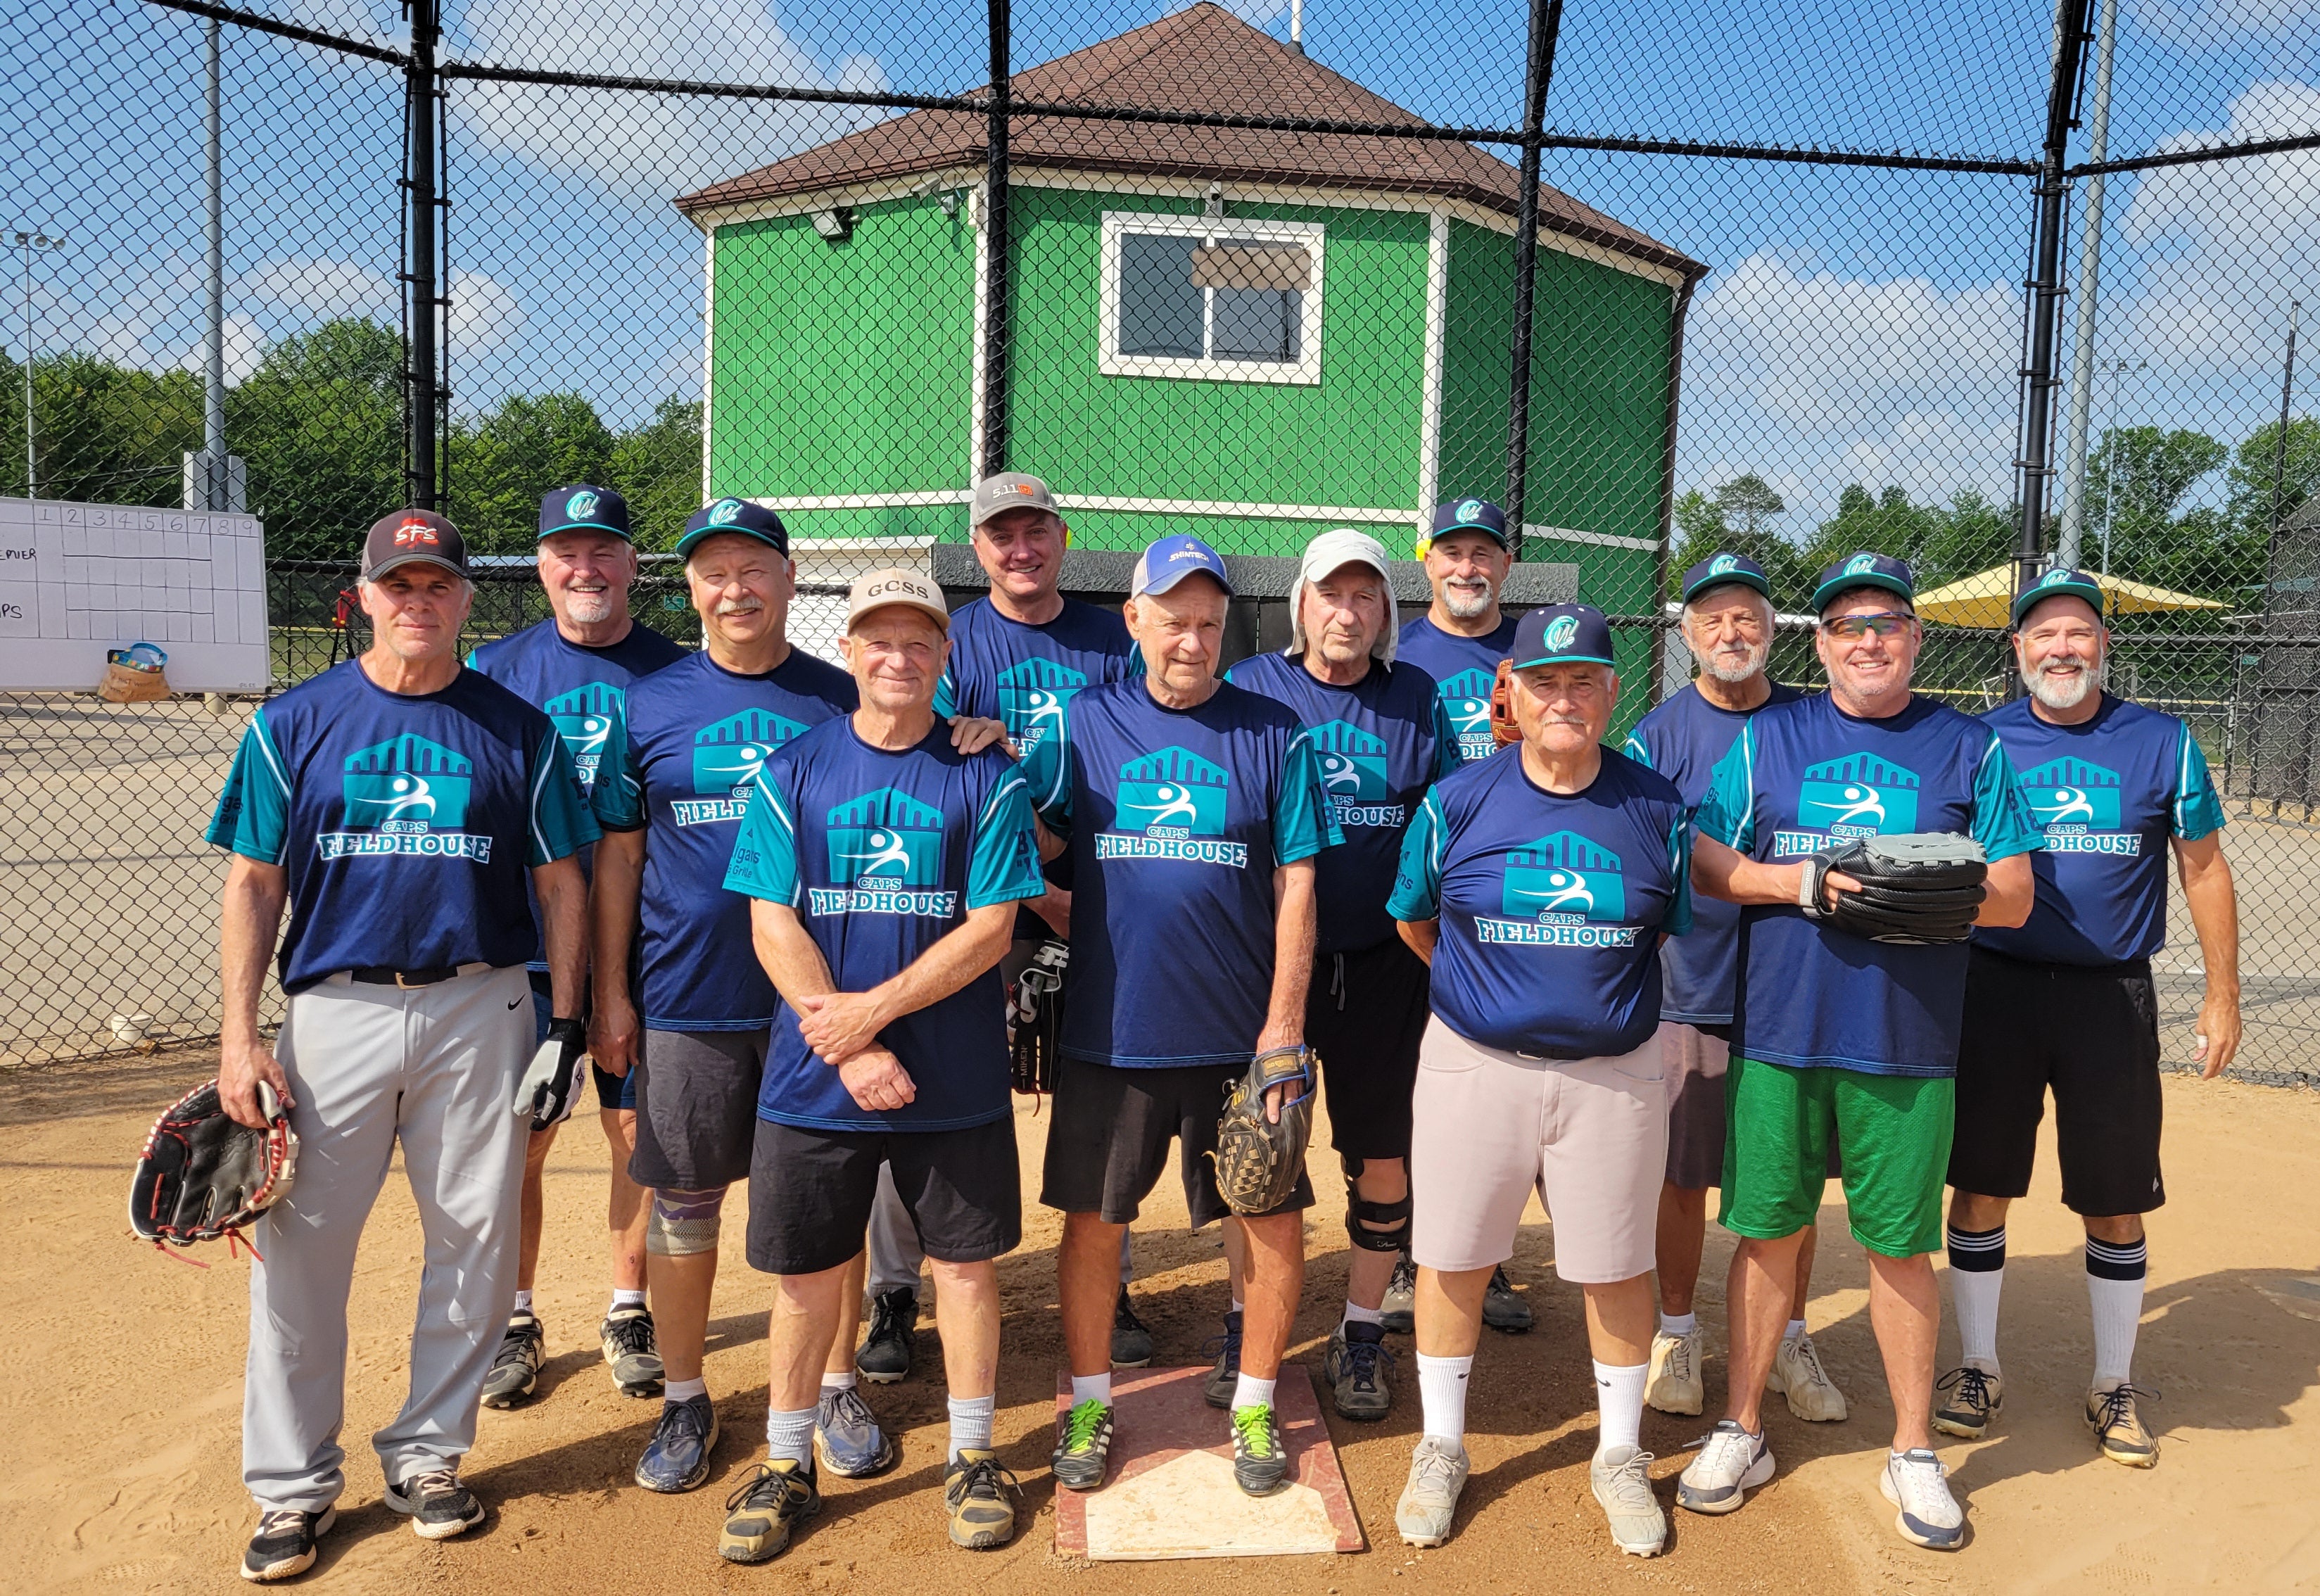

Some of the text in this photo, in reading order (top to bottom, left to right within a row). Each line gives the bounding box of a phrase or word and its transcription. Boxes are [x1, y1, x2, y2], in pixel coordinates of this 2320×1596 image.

[992, 483, 1019, 499] 5.11
[39, 509, 253, 536] 1 2 3 4 5 6 7 8 9
[395, 524, 437, 543] SFS
[868, 580, 929, 599] GCSS
[0, 603, 23, 619] PS
[1459, 733, 1493, 743] CAPS
[382, 820, 429, 833] CAPS
[1146, 825, 1190, 840] CAPS
[1830, 824, 1877, 838] CAPS
[2046, 824, 2087, 834] CAPS
[317, 832, 493, 865] FELDHOUSE
[1094, 832, 1248, 869] FIELDHOUSE
[858, 877, 903, 892] CAPS
[809, 887, 958, 918] FIELDHOUSE
[1539, 912, 1585, 925] CAPS
